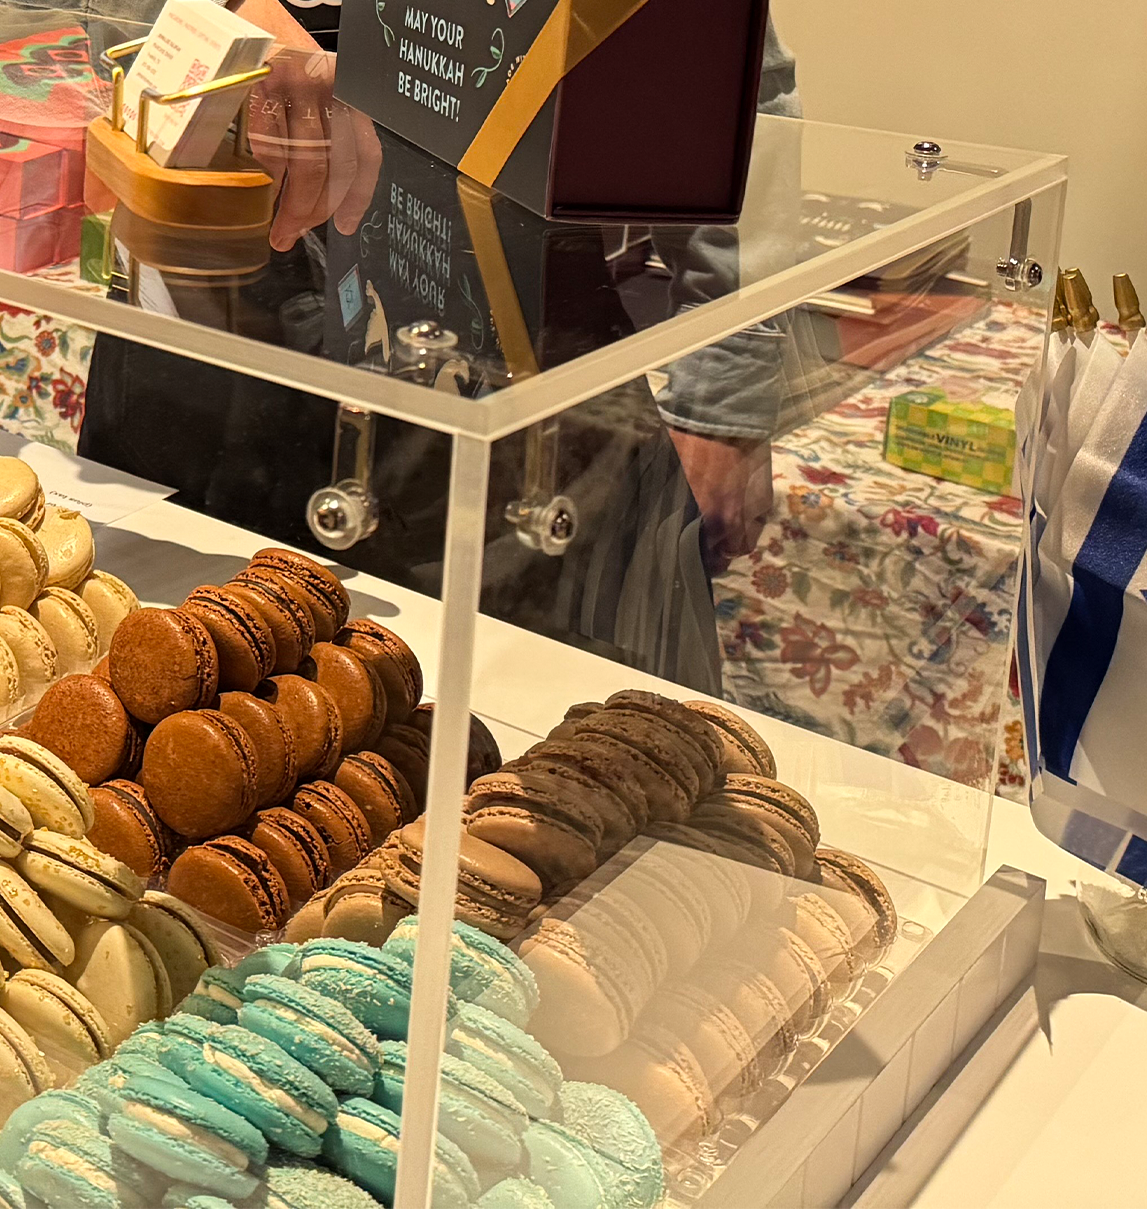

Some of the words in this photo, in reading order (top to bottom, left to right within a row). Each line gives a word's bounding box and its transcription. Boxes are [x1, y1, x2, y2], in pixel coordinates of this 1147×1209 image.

[404, 5, 429, 35] MAY
[430, 14, 465, 50] YOUR
[399, 37, 465, 87] HANUKKAH
[398, 71, 411, 97] BE
[413, 81, 461, 123] BRIGHT!
[936, 432, 977, 451] VINYL
